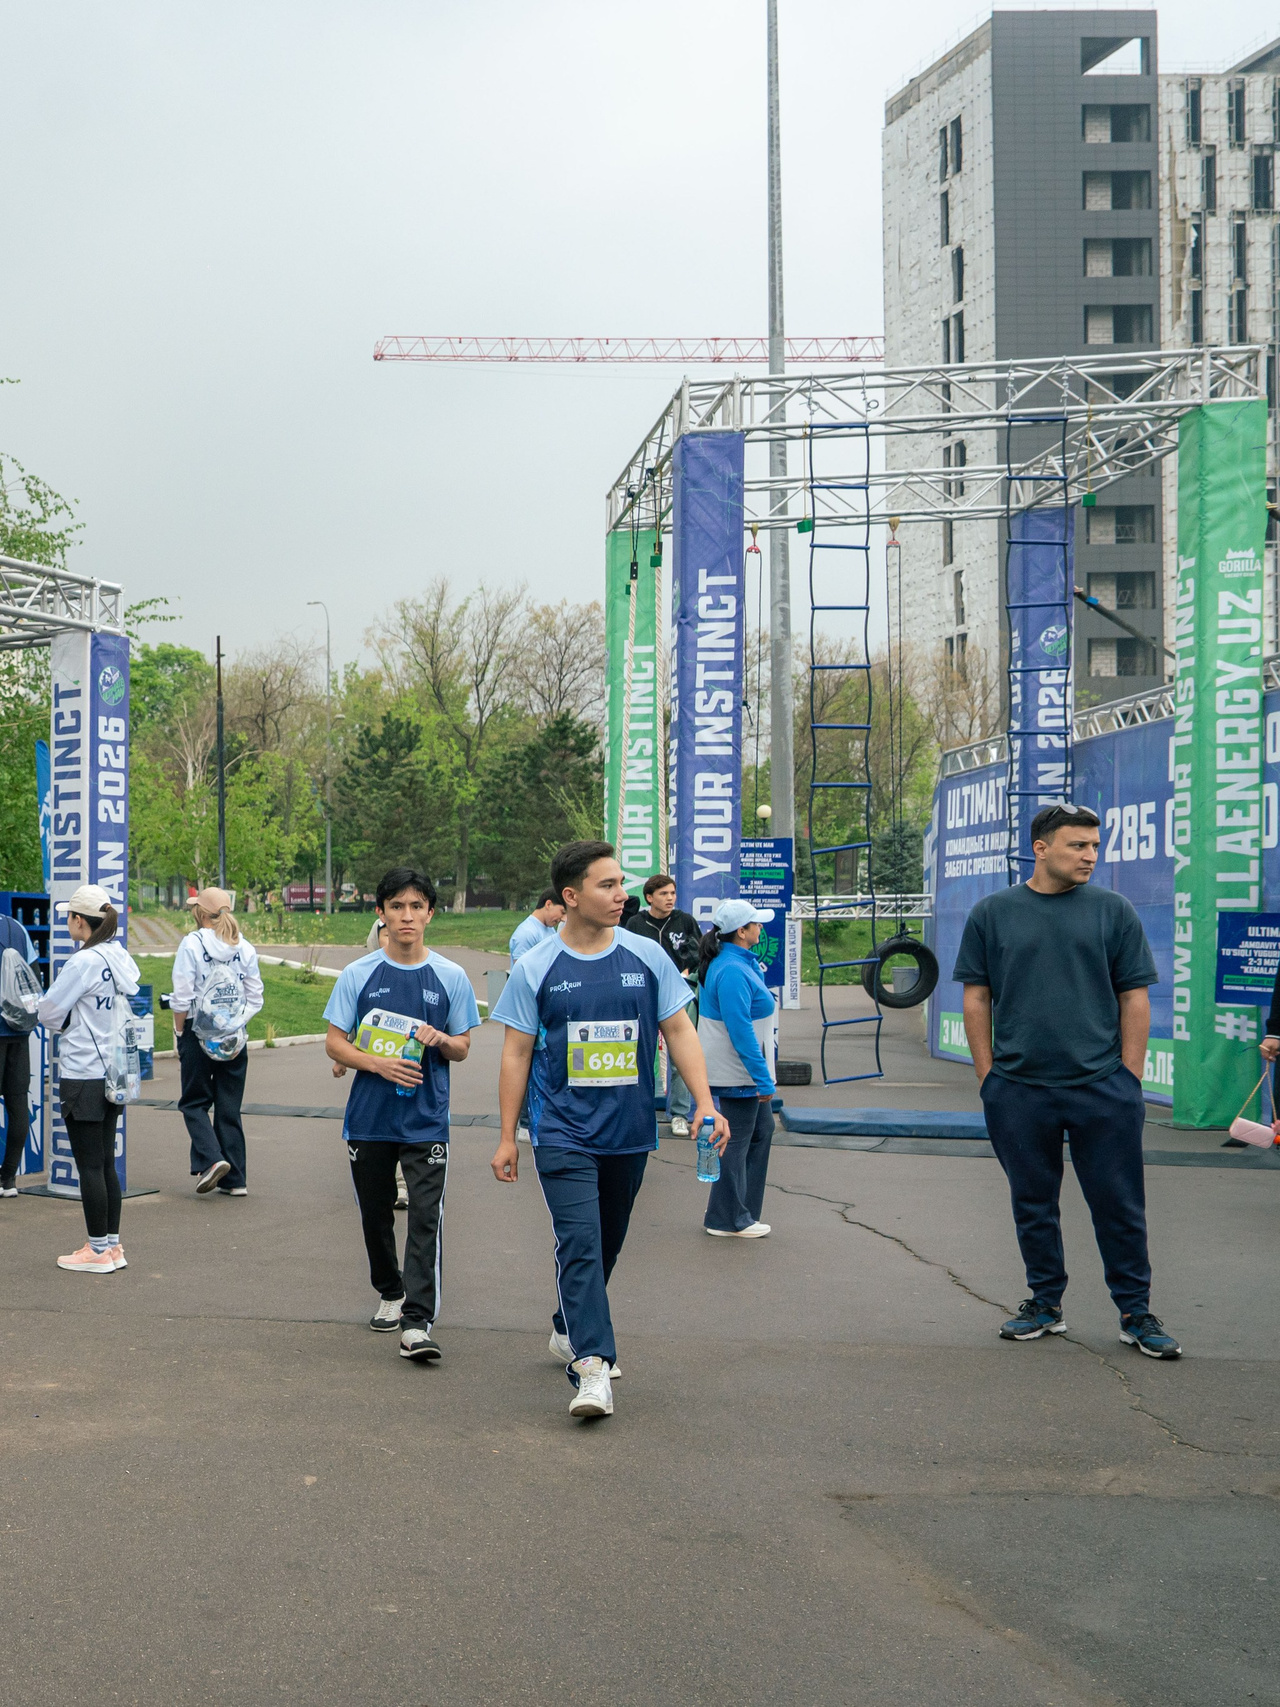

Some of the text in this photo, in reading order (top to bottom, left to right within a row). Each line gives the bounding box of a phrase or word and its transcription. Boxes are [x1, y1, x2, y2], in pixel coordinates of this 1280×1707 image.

[1219, 559, 1262, 573] GORILLA
[694, 568, 737, 756] INSTINCT
[53, 682, 82, 882] INSTINCT
[97, 715, 126, 825] 2026
[621, 639, 655, 891] YOUR INSTINCT
[1173, 554, 1196, 1041] POWER YOUR INSTINCT
[692, 772, 733, 881] YOUR
[1104, 801, 1156, 863] 285
[1214, 589, 1262, 1042] #LLAENERGY.UZ
[766, 936, 779, 958] MAY
[788, 924, 798, 1000] HISSIYOTINGA KUCH
[1248, 958, 1280, 967] 2-3 MAY
[549, 981, 582, 993] PRO RUN
[588, 1051, 636, 1071] 6942
[942, 1019, 949, 1044] 3
